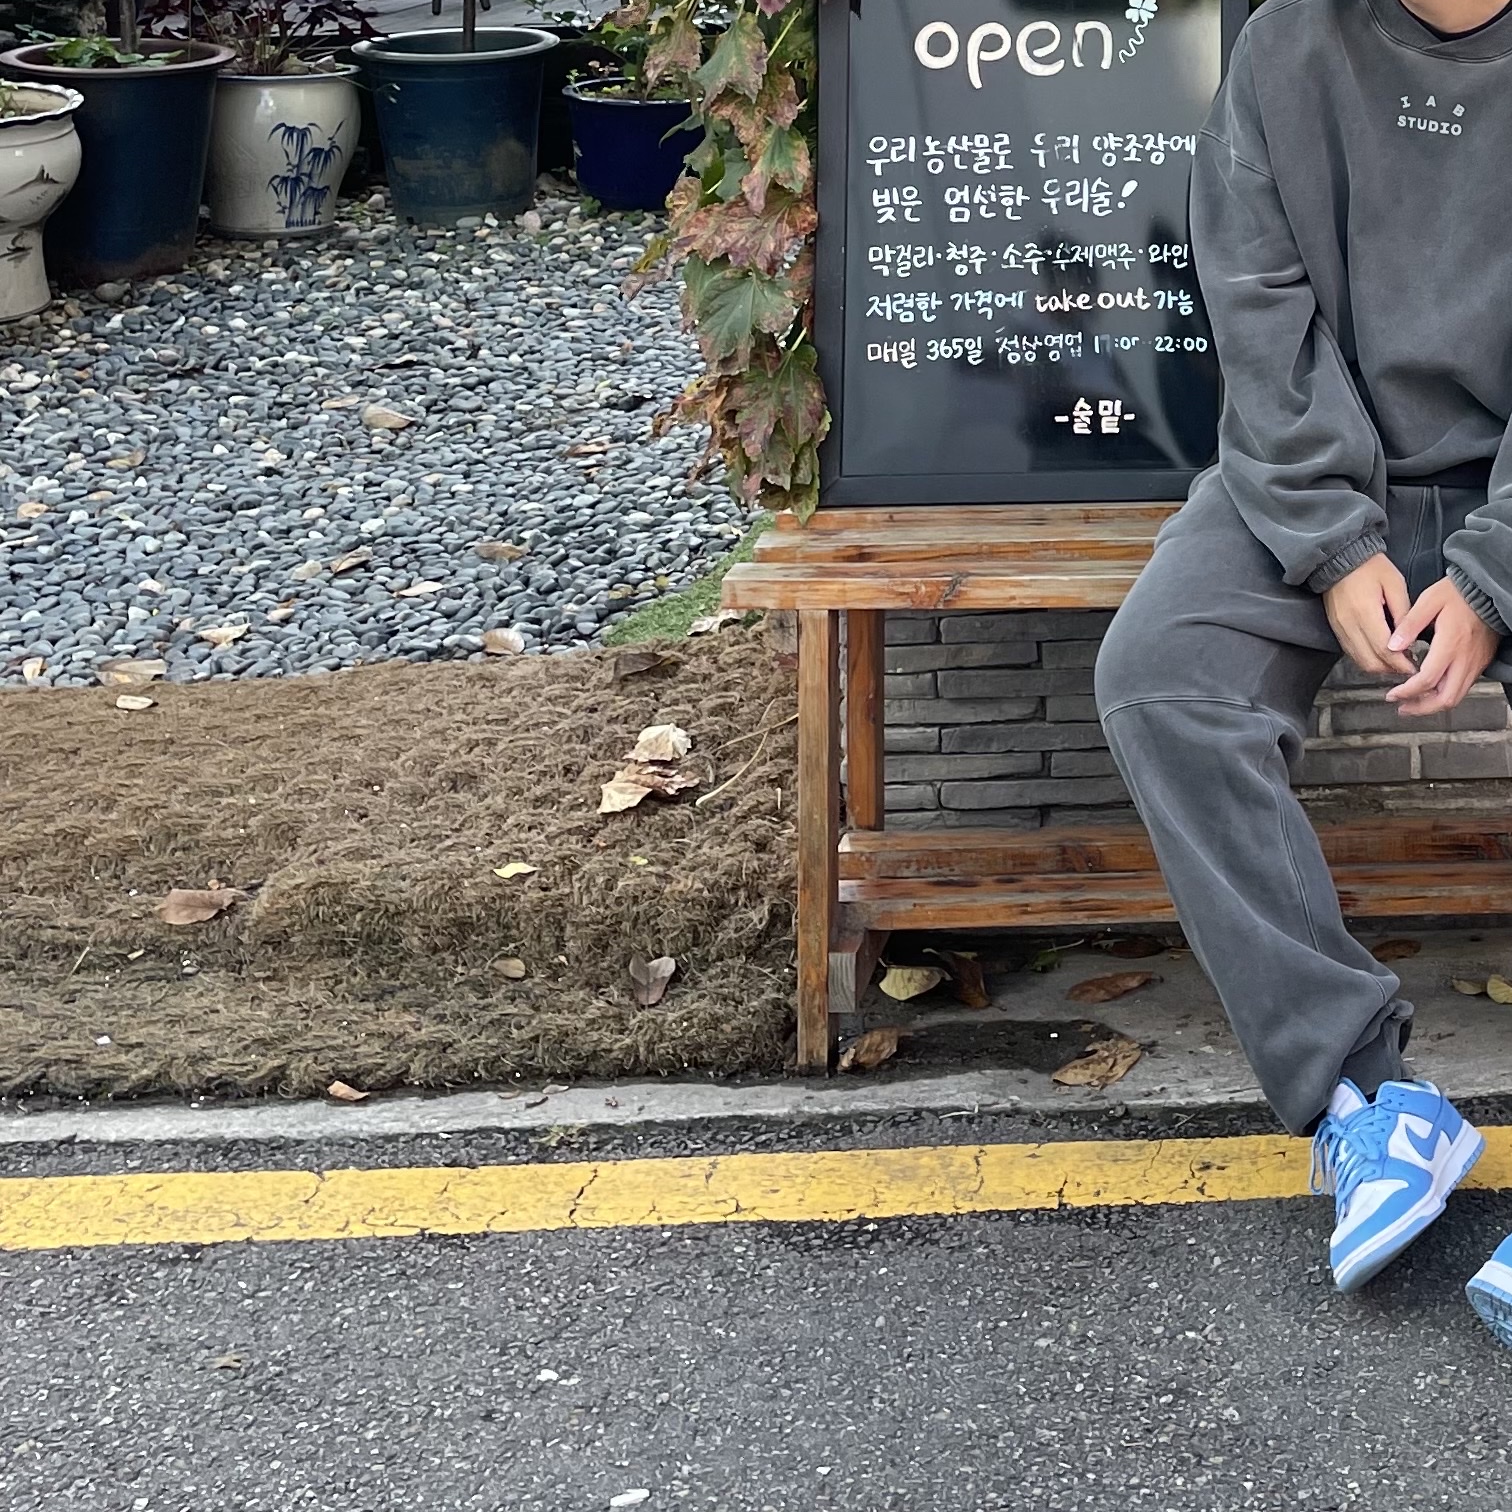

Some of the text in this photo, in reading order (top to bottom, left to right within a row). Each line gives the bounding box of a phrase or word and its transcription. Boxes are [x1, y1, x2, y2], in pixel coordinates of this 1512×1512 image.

[914, 20, 1113, 90] open
[1396, 114, 1463, 136] STUDIO
[865, 132, 1197, 176] 우리 농산물로 우리 양조장에
[872, 185, 923, 224] 빚은
[944, 183, 1031, 223] 엄선한
[865, 287, 1195, 323] 저렴한 가격에 take out 가능
[867, 337, 918, 369] 매일
[925, 335, 984, 366] 365일
[1153, 335, 1208, 354] 22:00
